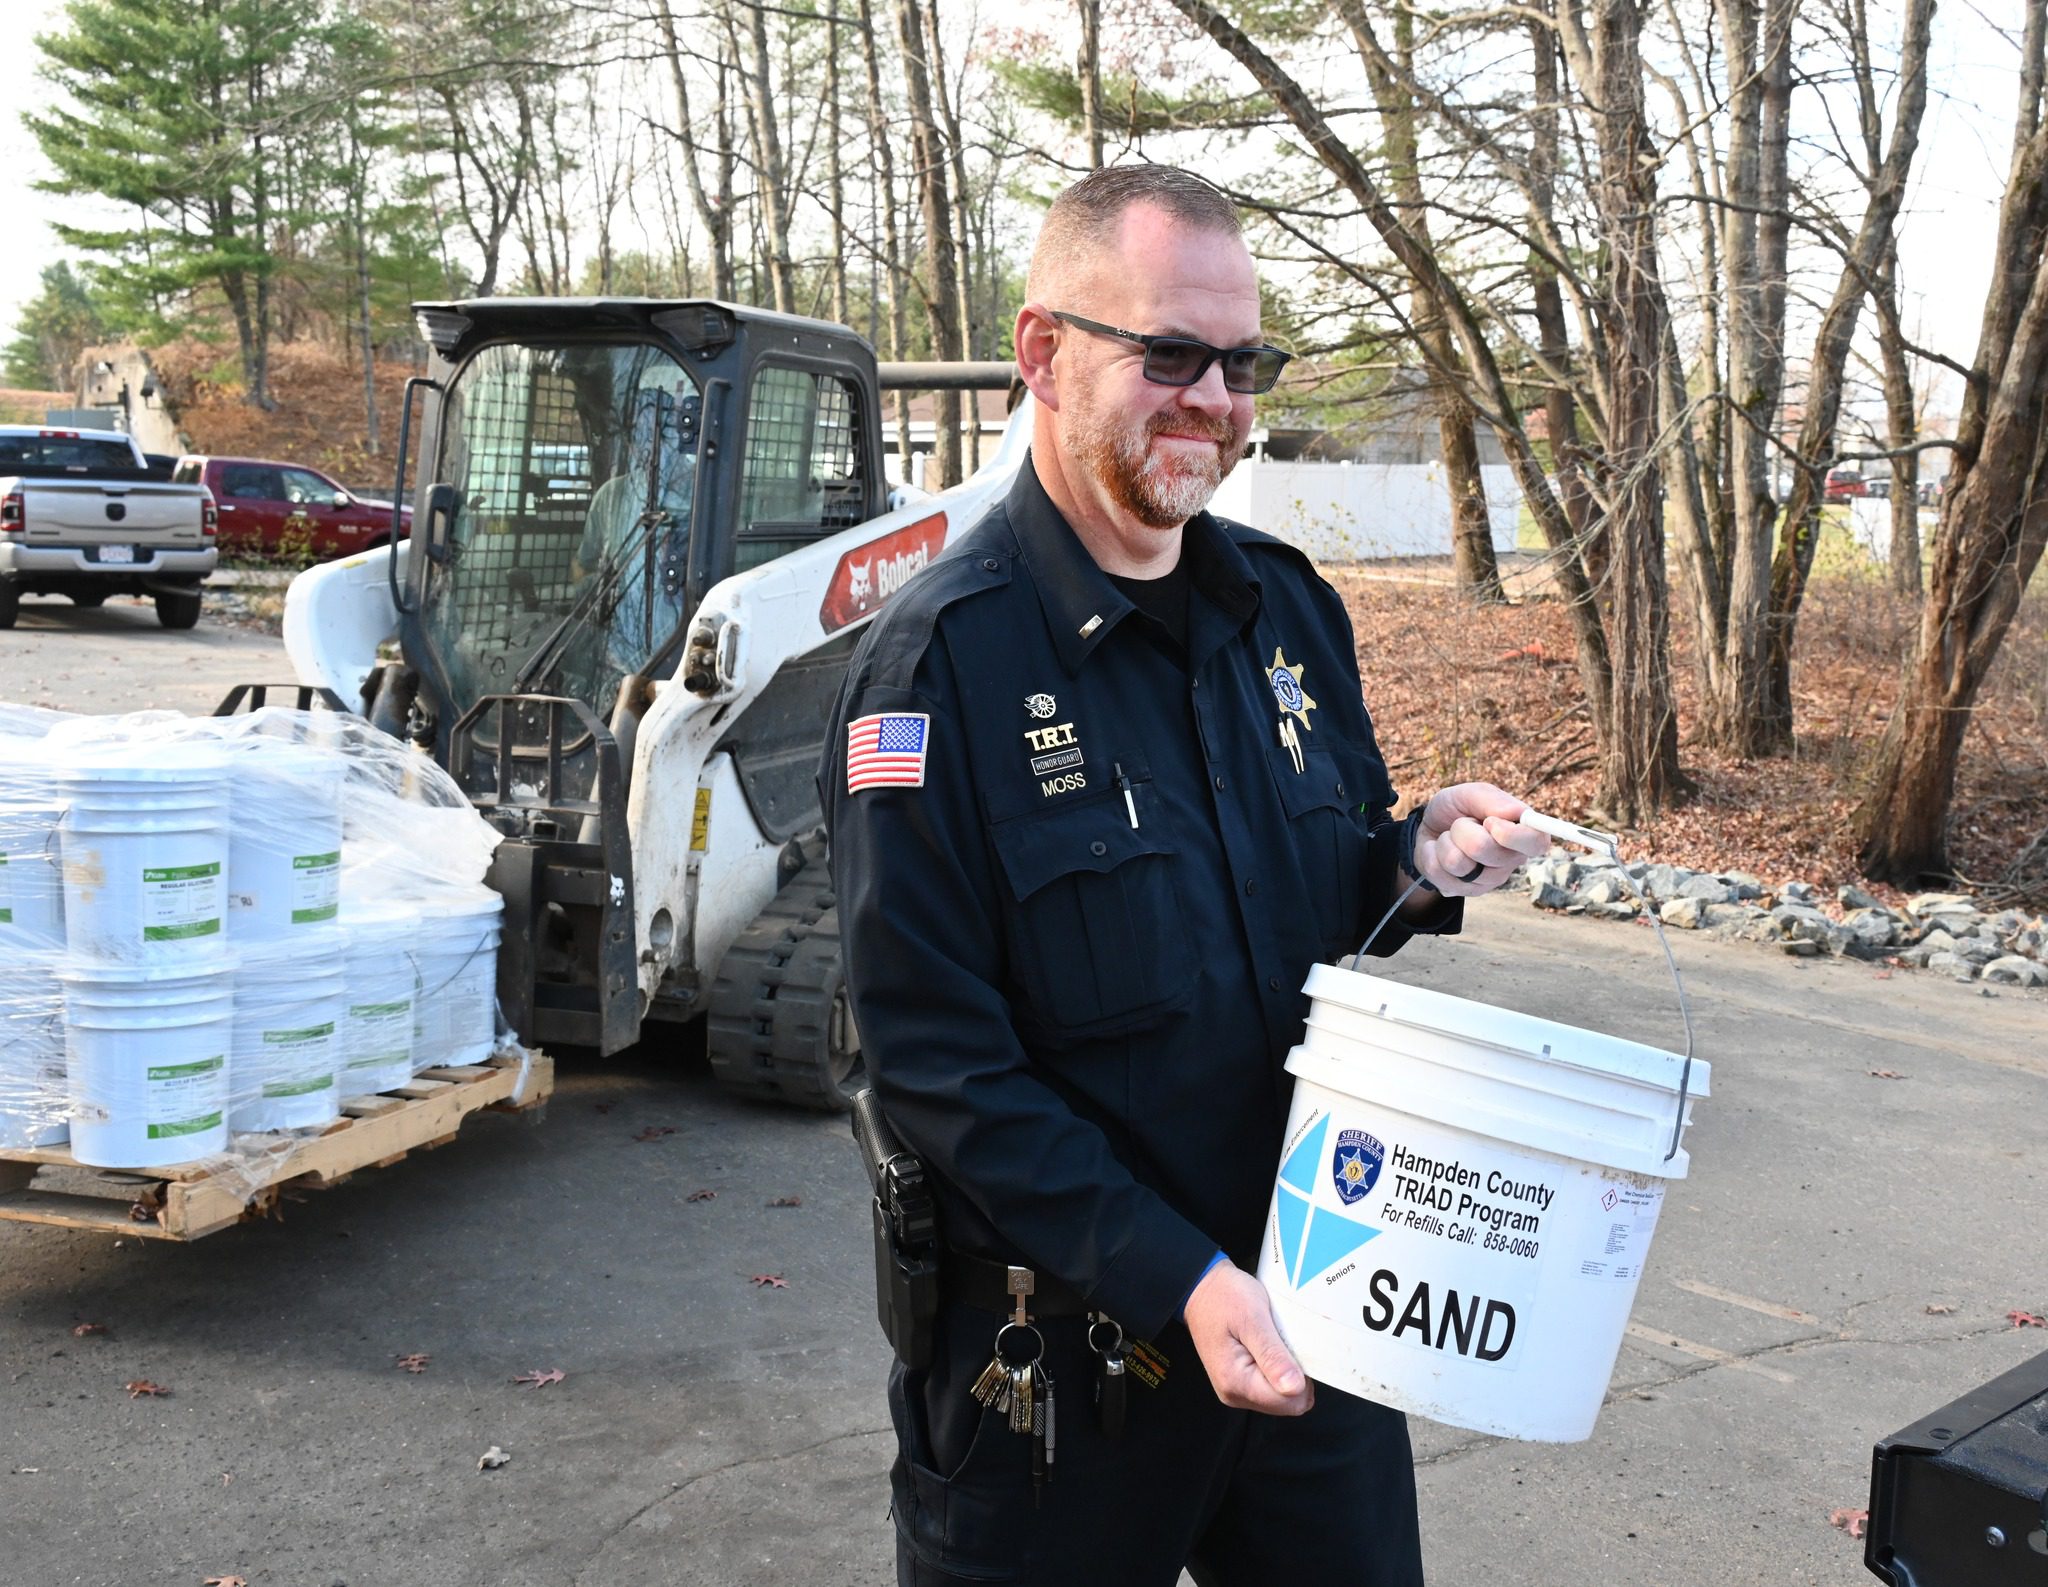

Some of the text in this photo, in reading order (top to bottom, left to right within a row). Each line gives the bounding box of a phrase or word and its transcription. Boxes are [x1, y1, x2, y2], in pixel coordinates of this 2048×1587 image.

[877, 541, 928, 598] Bobcat
[1024, 722, 1078, 751] T.R.T.
[1041, 772, 1086, 798] MOSS
[1337, 1140, 1383, 1162] HAMPDEN COUNTY
[1341, 1130, 1383, 1150] SHERIFF
[1391, 1144, 1555, 1211] Hampden County
[1395, 1174, 1539, 1233] TRIAD Program
[1380, 1202, 1539, 1259] For Refills Call: 858-0060
[1325, 1262, 1356, 1285] Seniors
[1363, 1269, 1516, 1361] SAND
